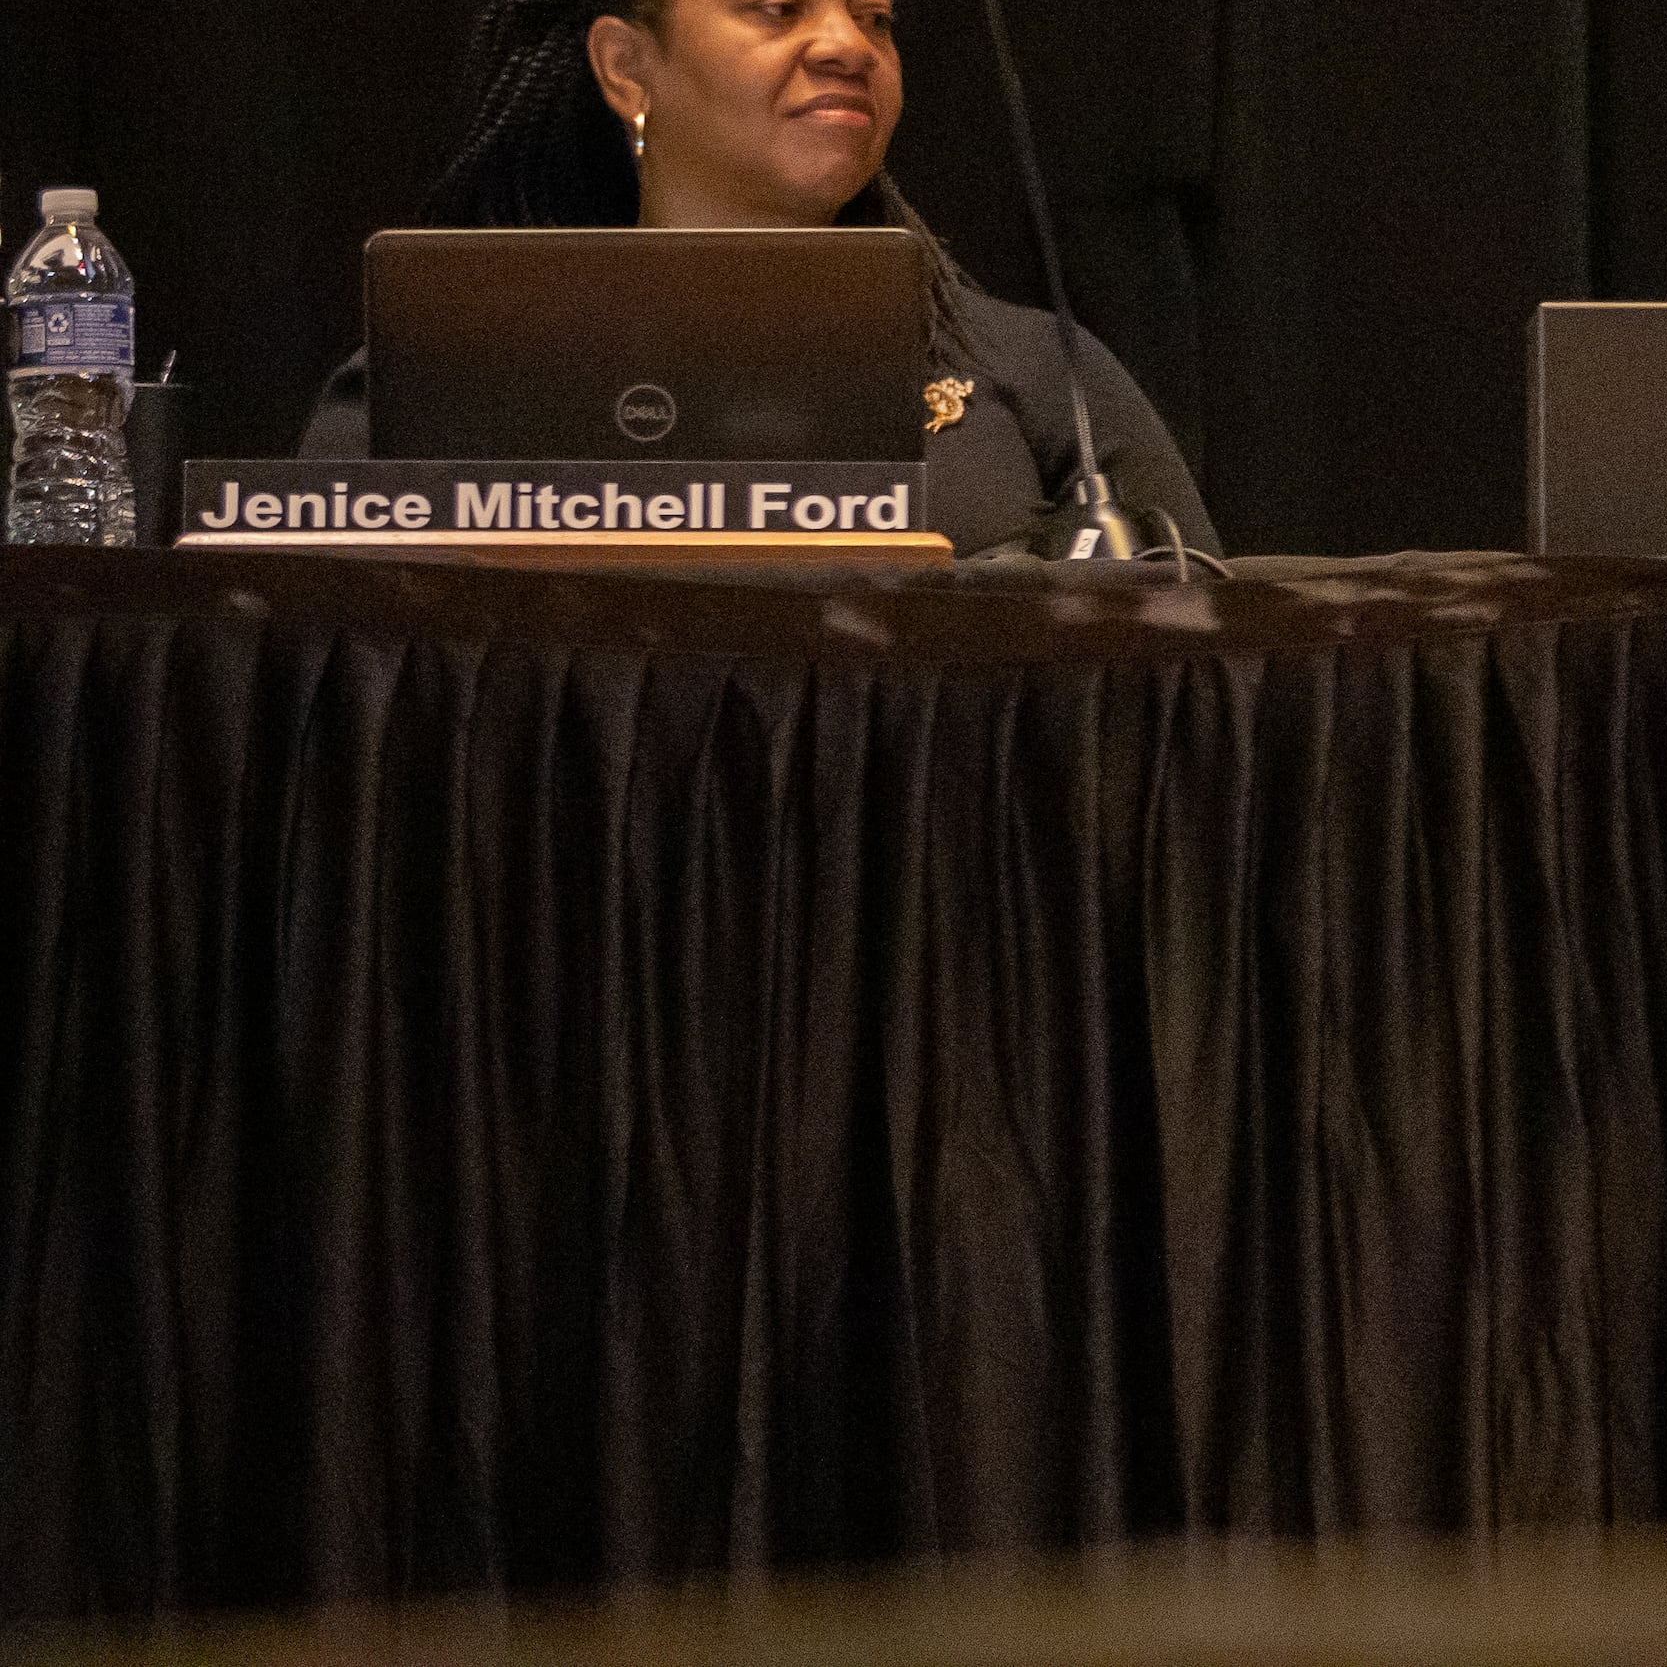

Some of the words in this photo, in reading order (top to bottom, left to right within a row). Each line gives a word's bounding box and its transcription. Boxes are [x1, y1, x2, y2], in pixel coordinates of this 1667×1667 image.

[201, 481, 432, 529] Jenice
[455, 481, 726, 530] Mitchell
[750, 483, 909, 530] Ford
[1079, 537, 1092, 552] 2
